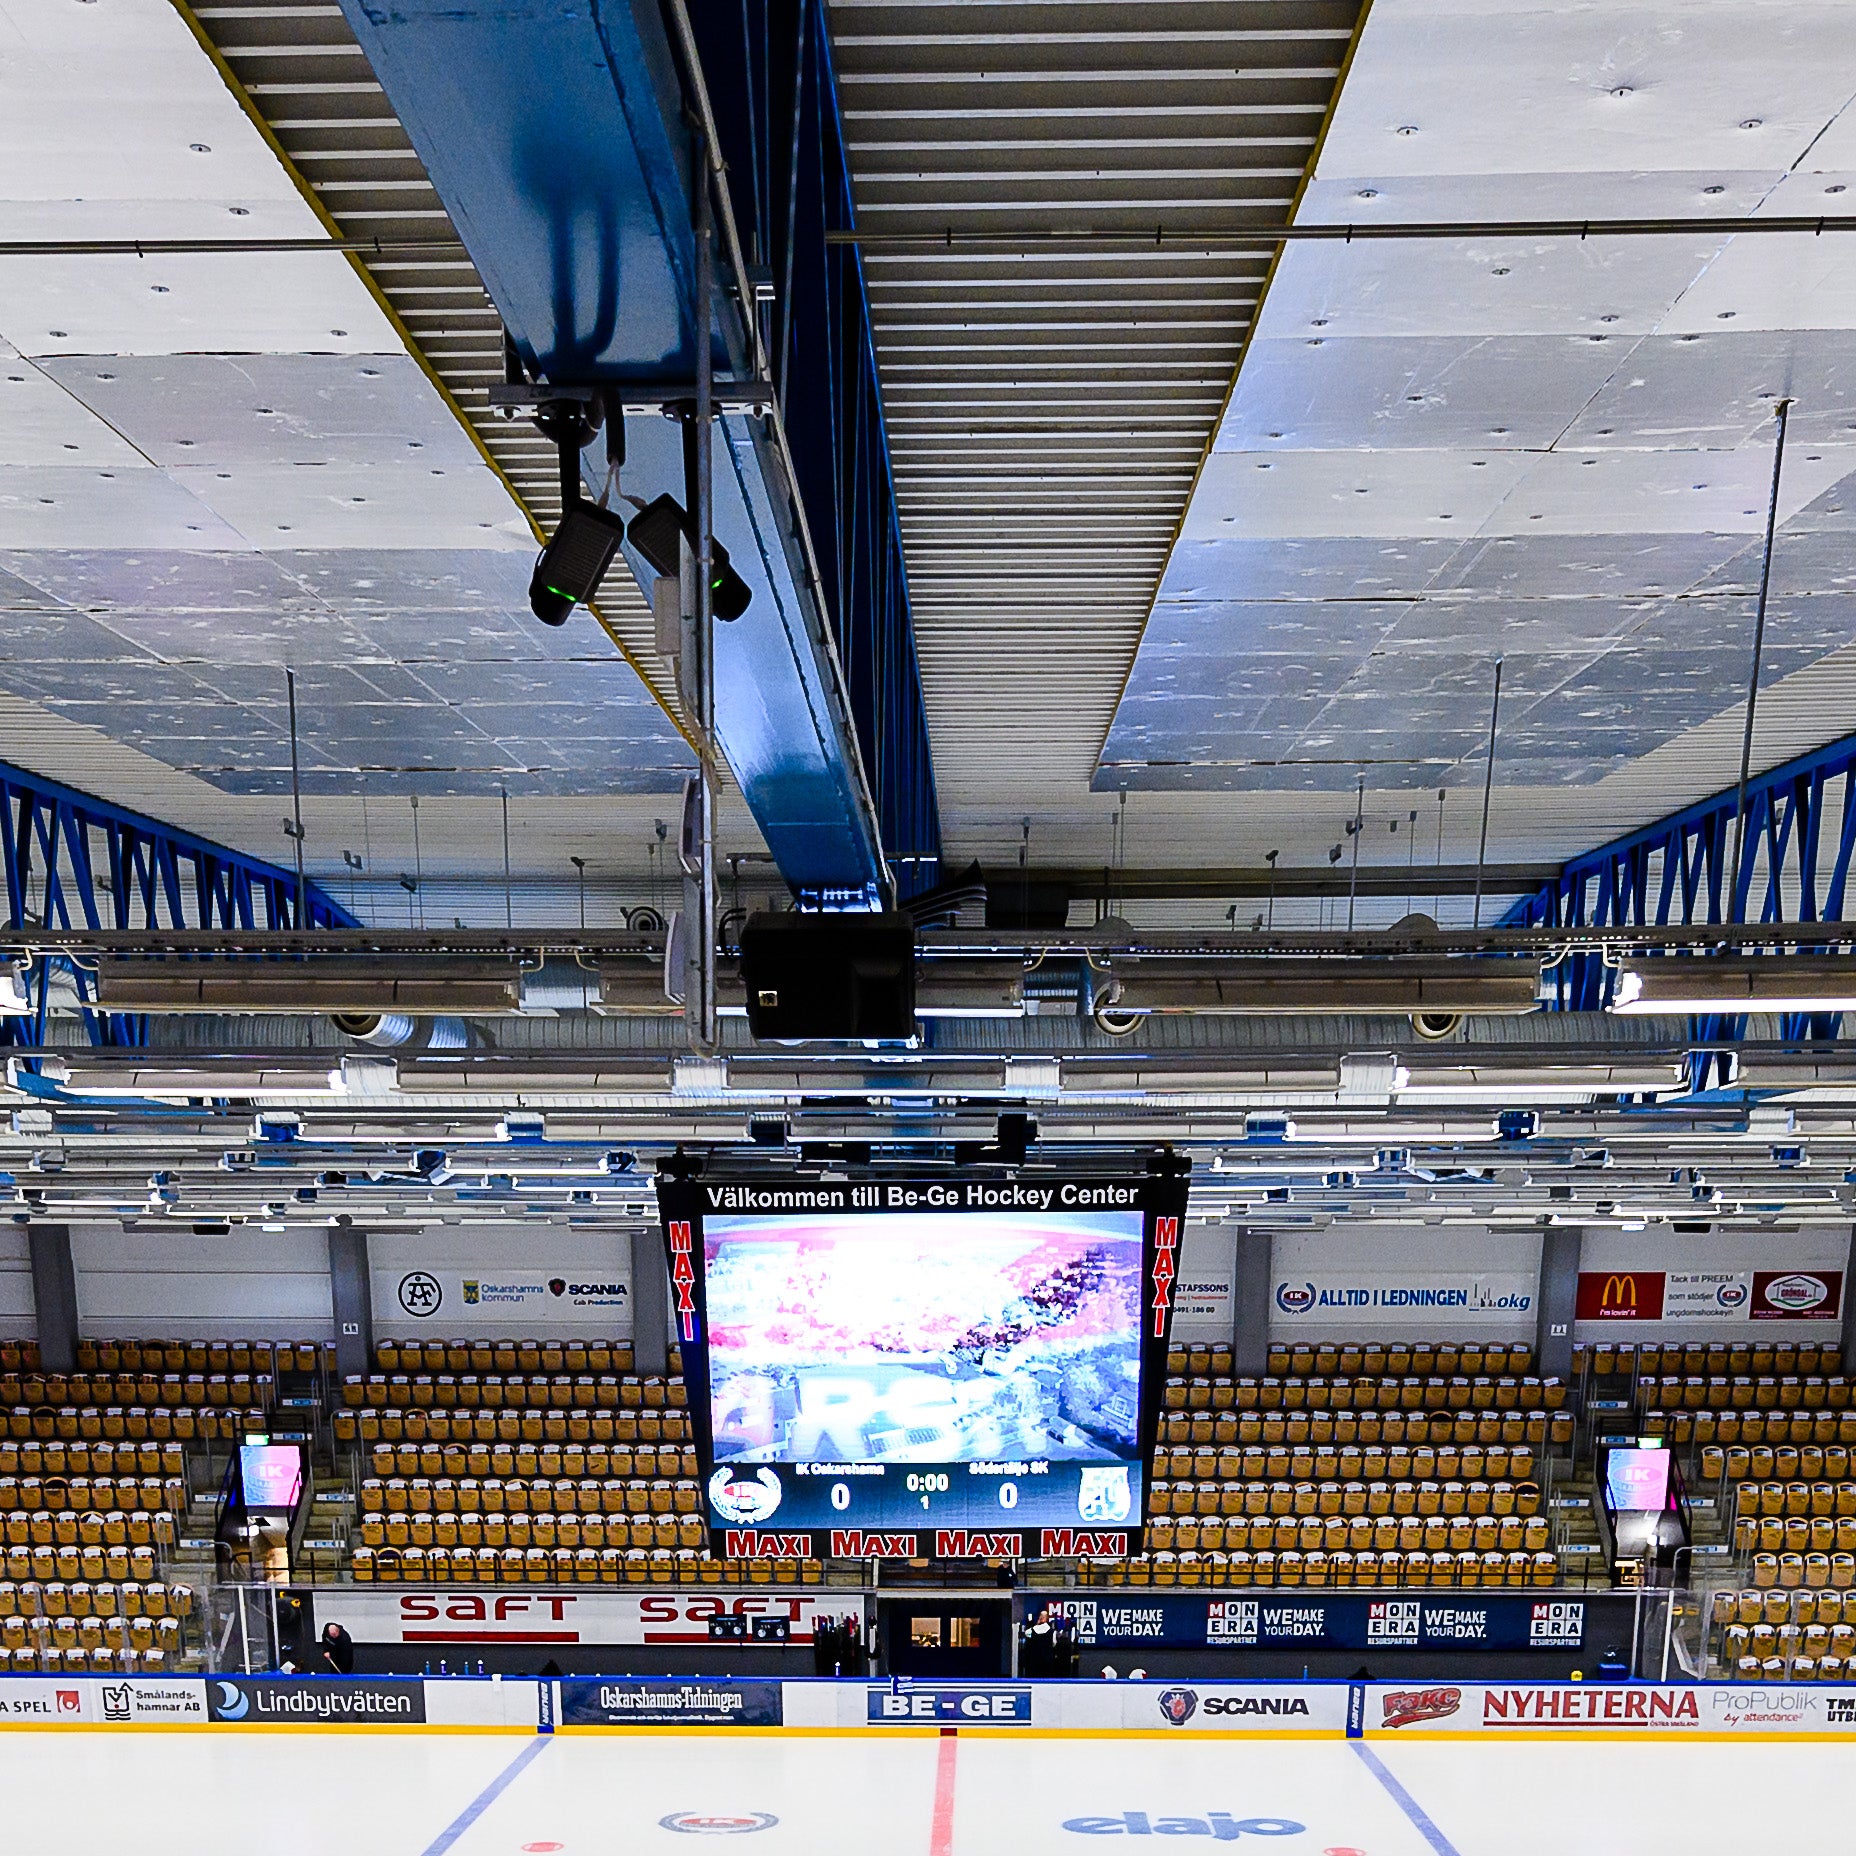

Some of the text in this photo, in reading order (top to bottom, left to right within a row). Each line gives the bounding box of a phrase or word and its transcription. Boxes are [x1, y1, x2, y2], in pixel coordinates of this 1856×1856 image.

[707, 1183, 1139, 1210] Välkommen till Be-Ge Hockey Center
[1671, 1275, 1689, 1283] Tack
[1701, 1275, 1734, 1283] PREEM
[481, 1284, 544, 1294] Oskarshamns
[568, 1284, 628, 1296] SCANIA
[1318, 1289, 1369, 1306] ALLTID
[1381, 1289, 1468, 1306] LEDNINGEN
[1497, 1293, 1531, 1311] okg
[906, 1474, 949, 1492] 0:00
[831, 1483, 850, 1510] 0
[998, 1482, 1018, 1508] 0
[1102, 1609, 1163, 1625] WE MAKE
[1264, 1609, 1324, 1625] WE MAKE
[1425, 1609, 1486, 1626] WE MAKE
[1103, 1626, 1132, 1636] YOUR
[1132, 1624, 1164, 1636] DAY.
[1264, 1624, 1325, 1636] YOUR DAY.
[1425, 1625, 1487, 1638] YOUR DAY.
[136, 1689, 197, 1700] Smålands-
[600, 1686, 743, 1713] Oskarshamns-Tidningen
[1712, 1691, 1817, 1710] ProPublik
[14, 1700, 52, 1713] SPEL
[136, 1702, 201, 1712] hamnar AB
[257, 1690, 412, 1718] Lindbytvätten
[1203, 1698, 1310, 1716] SCANIA
[1483, 1690, 1699, 1719] NYHETERNA
[1826, 1698, 1856, 1710] TM
[1061, 1811, 1307, 1842] elajo
